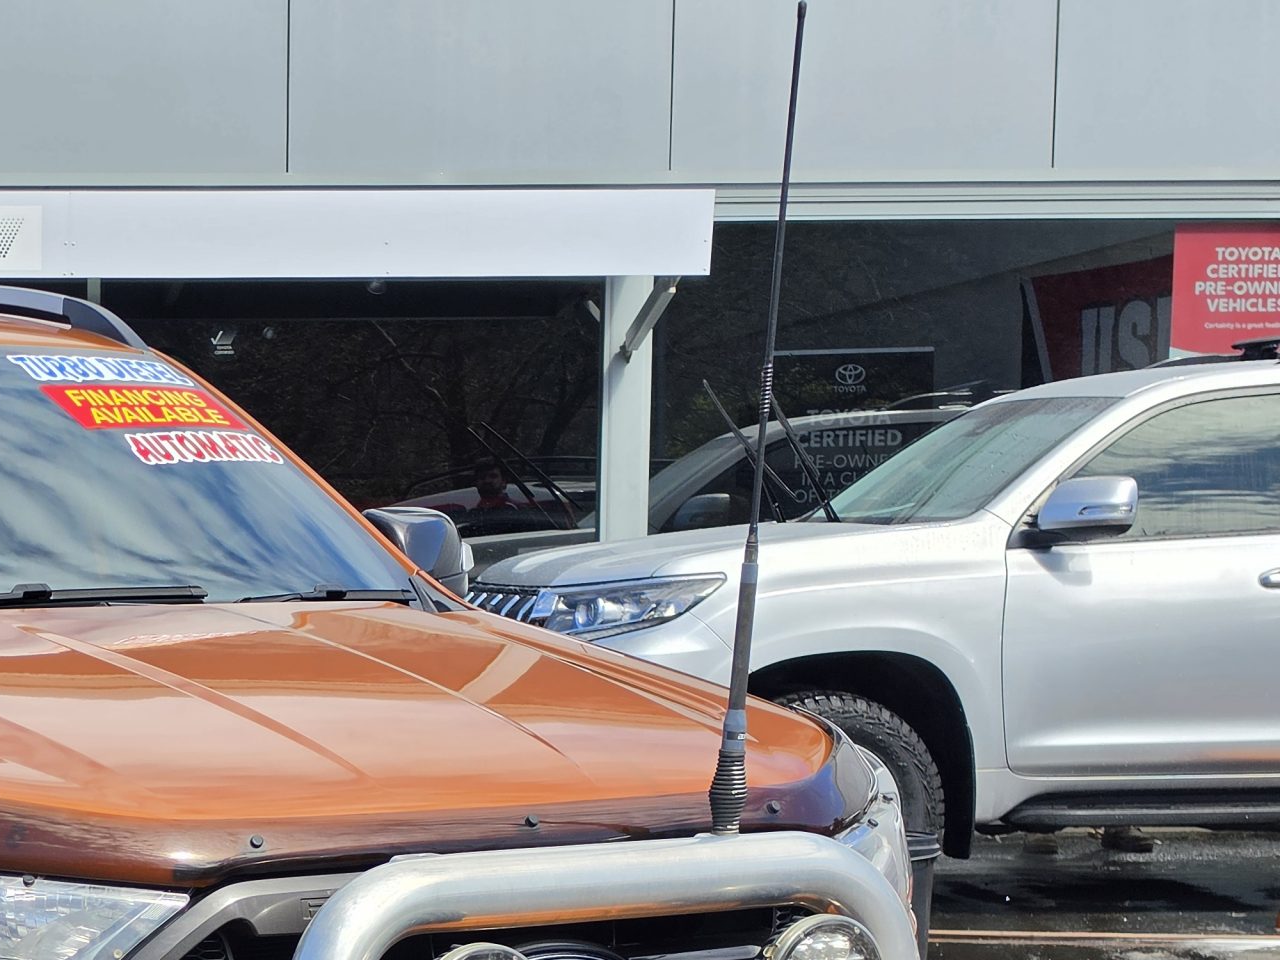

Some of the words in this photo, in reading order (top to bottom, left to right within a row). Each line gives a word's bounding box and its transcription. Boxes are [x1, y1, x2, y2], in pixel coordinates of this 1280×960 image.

[1206, 264, 1280, 279] CERTIFIE
[1194, 280, 1280, 296] PRE-OWN
[9, 355, 99, 382] TURBO
[98, 358, 194, 386] DIESEL
[64, 388, 207, 408] FINANCING
[833, 385, 867, 393] TOYOTA
[90, 406, 231, 425] AVAILABLE
[127, 432, 282, 464] AUTOMATIC
[795, 429, 903, 448] CERTIFIED
